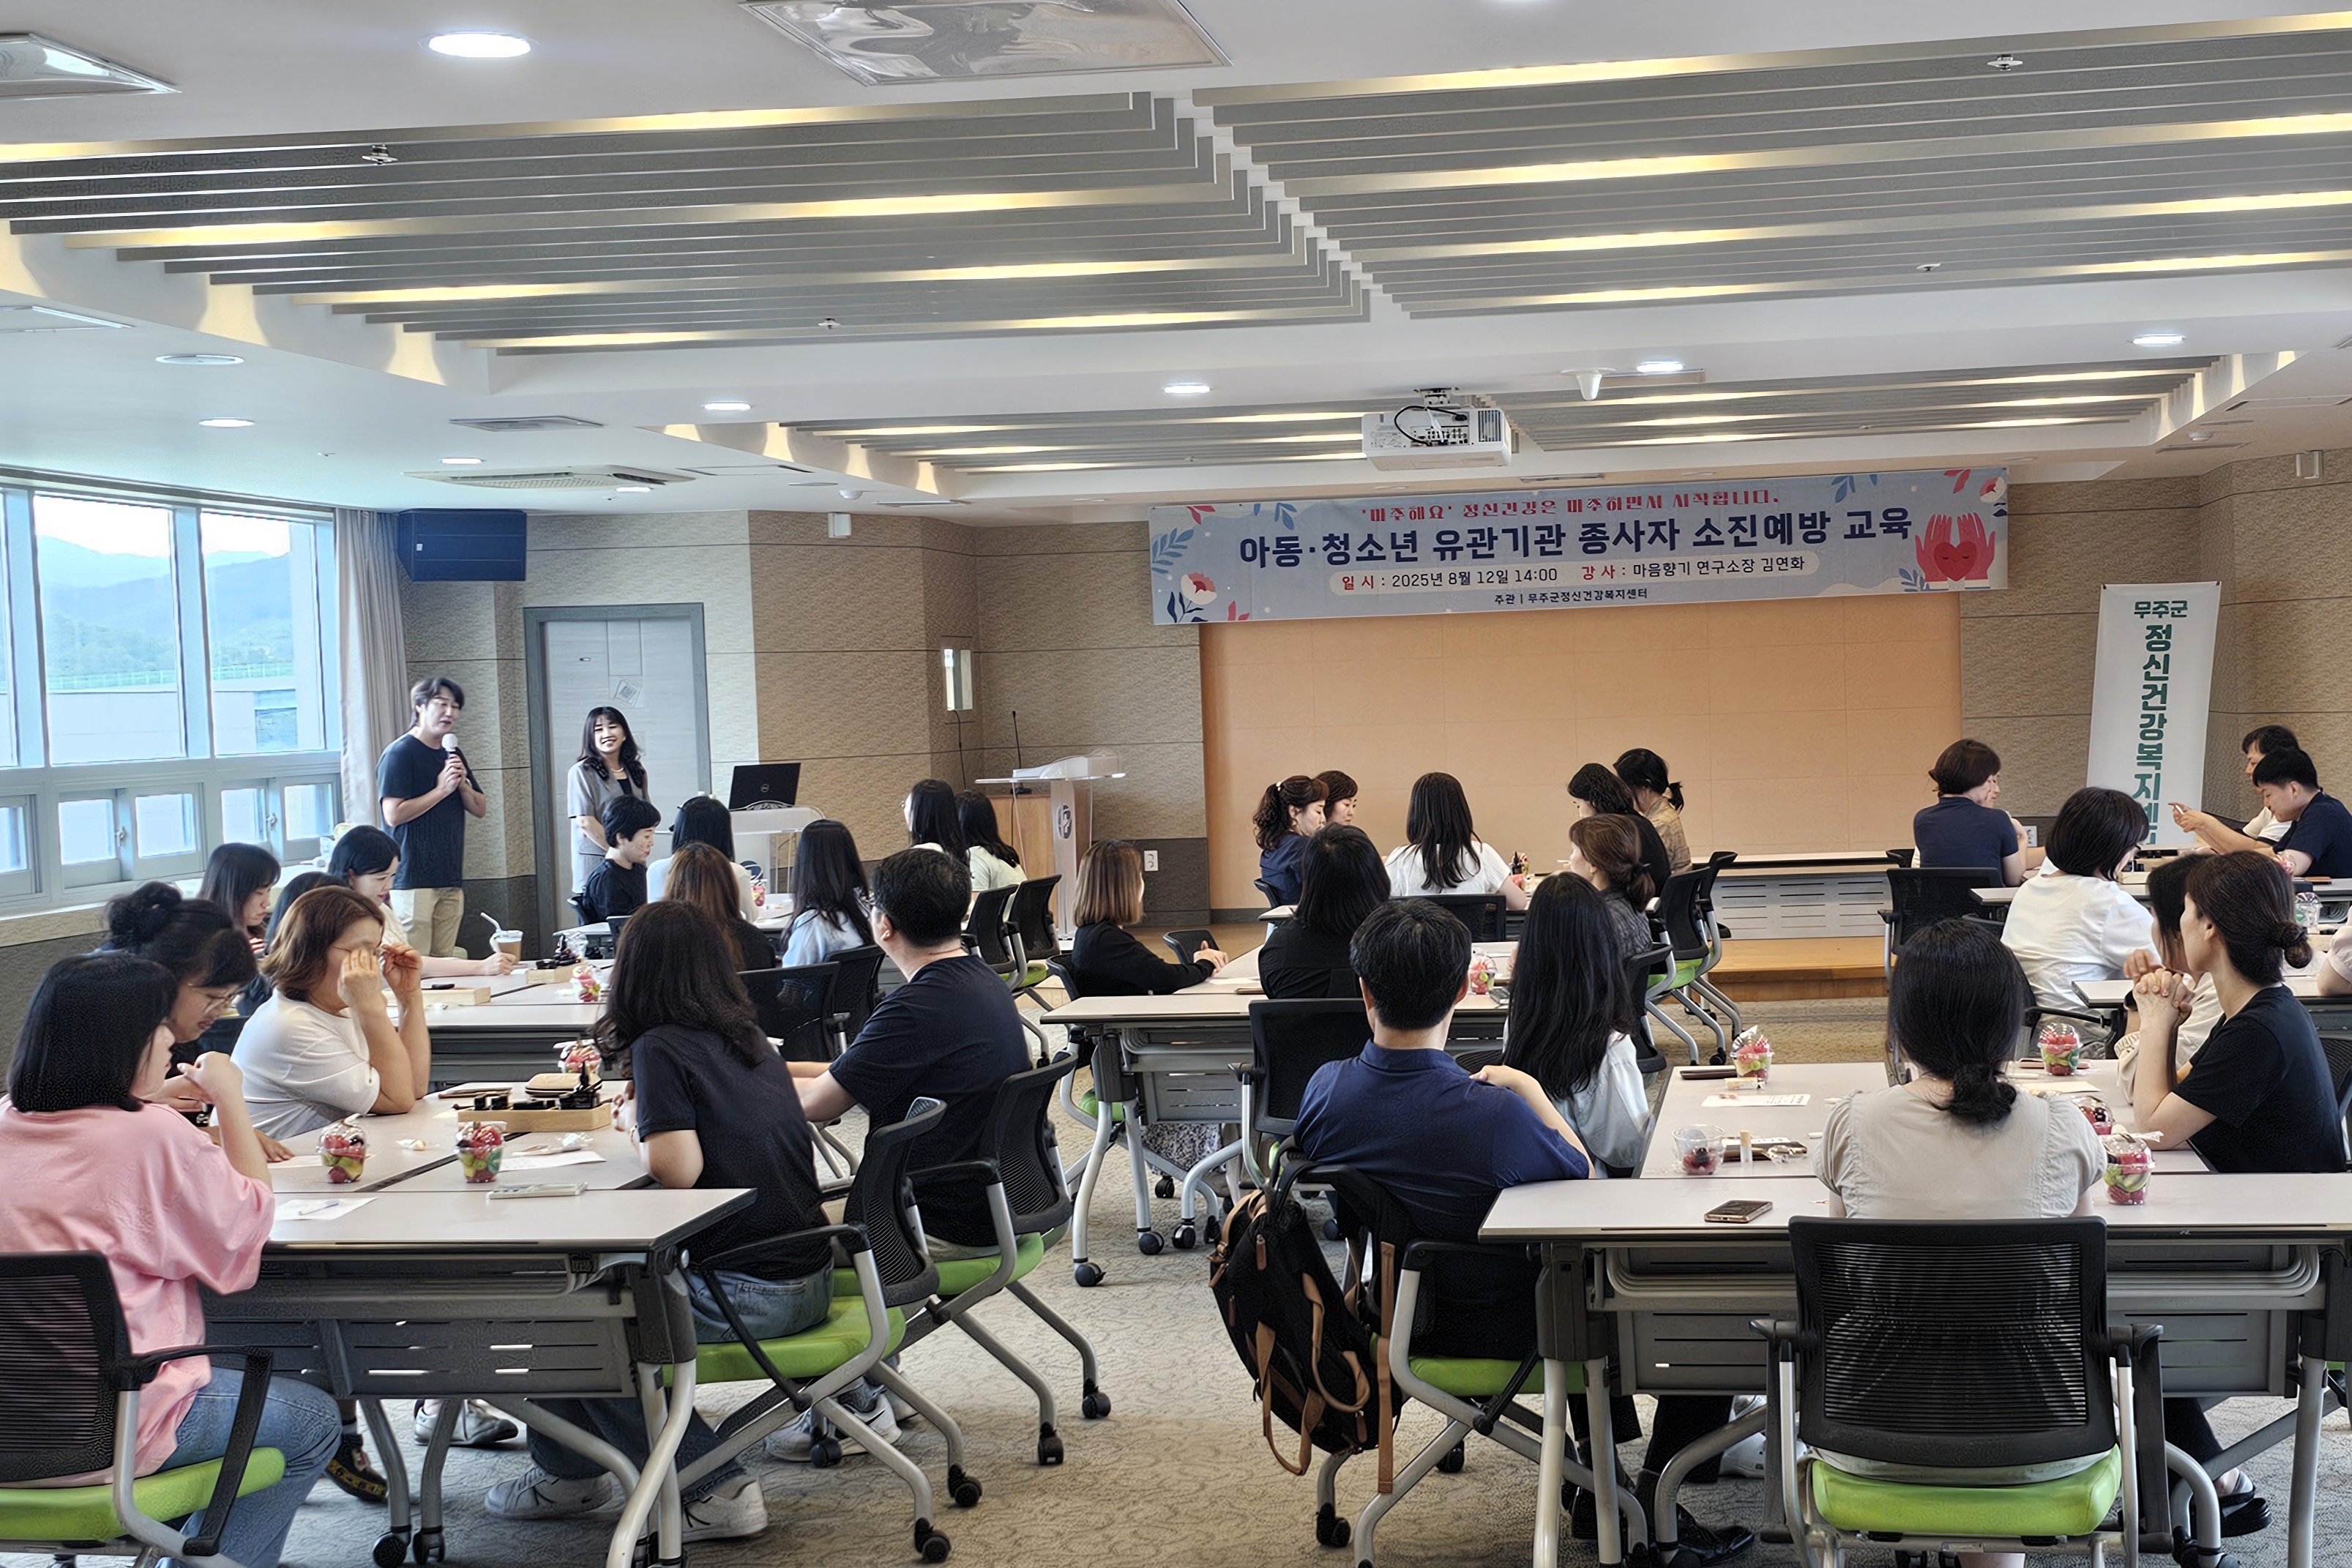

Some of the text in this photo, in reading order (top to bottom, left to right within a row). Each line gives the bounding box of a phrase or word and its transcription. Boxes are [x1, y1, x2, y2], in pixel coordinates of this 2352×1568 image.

[1463, 501, 1556, 518] 정신건강은
[1567, 495, 1662, 512] 마주하면서
[1673, 490, 1779, 507] 시작합니다.
[1239, 507, 1912, 569] 아동·청소년 유관기관 종사자 소진예방 교육
[1392, 572, 1443, 587] 2025년
[1449, 571, 1471, 586] 8월
[1477, 570, 1508, 585] 12일
[1515, 568, 1558, 583] 14:00
[1633, 561, 1690, 578] 마음향기
[1697, 559, 1755, 575] 연구소장
[1761, 556, 1804, 572] 김연화
[1495, 594, 1515, 605] 주관
[1528, 588, 1648, 604] 무주군정신건강복지센터
[2133, 600, 2188, 619] 무주군
